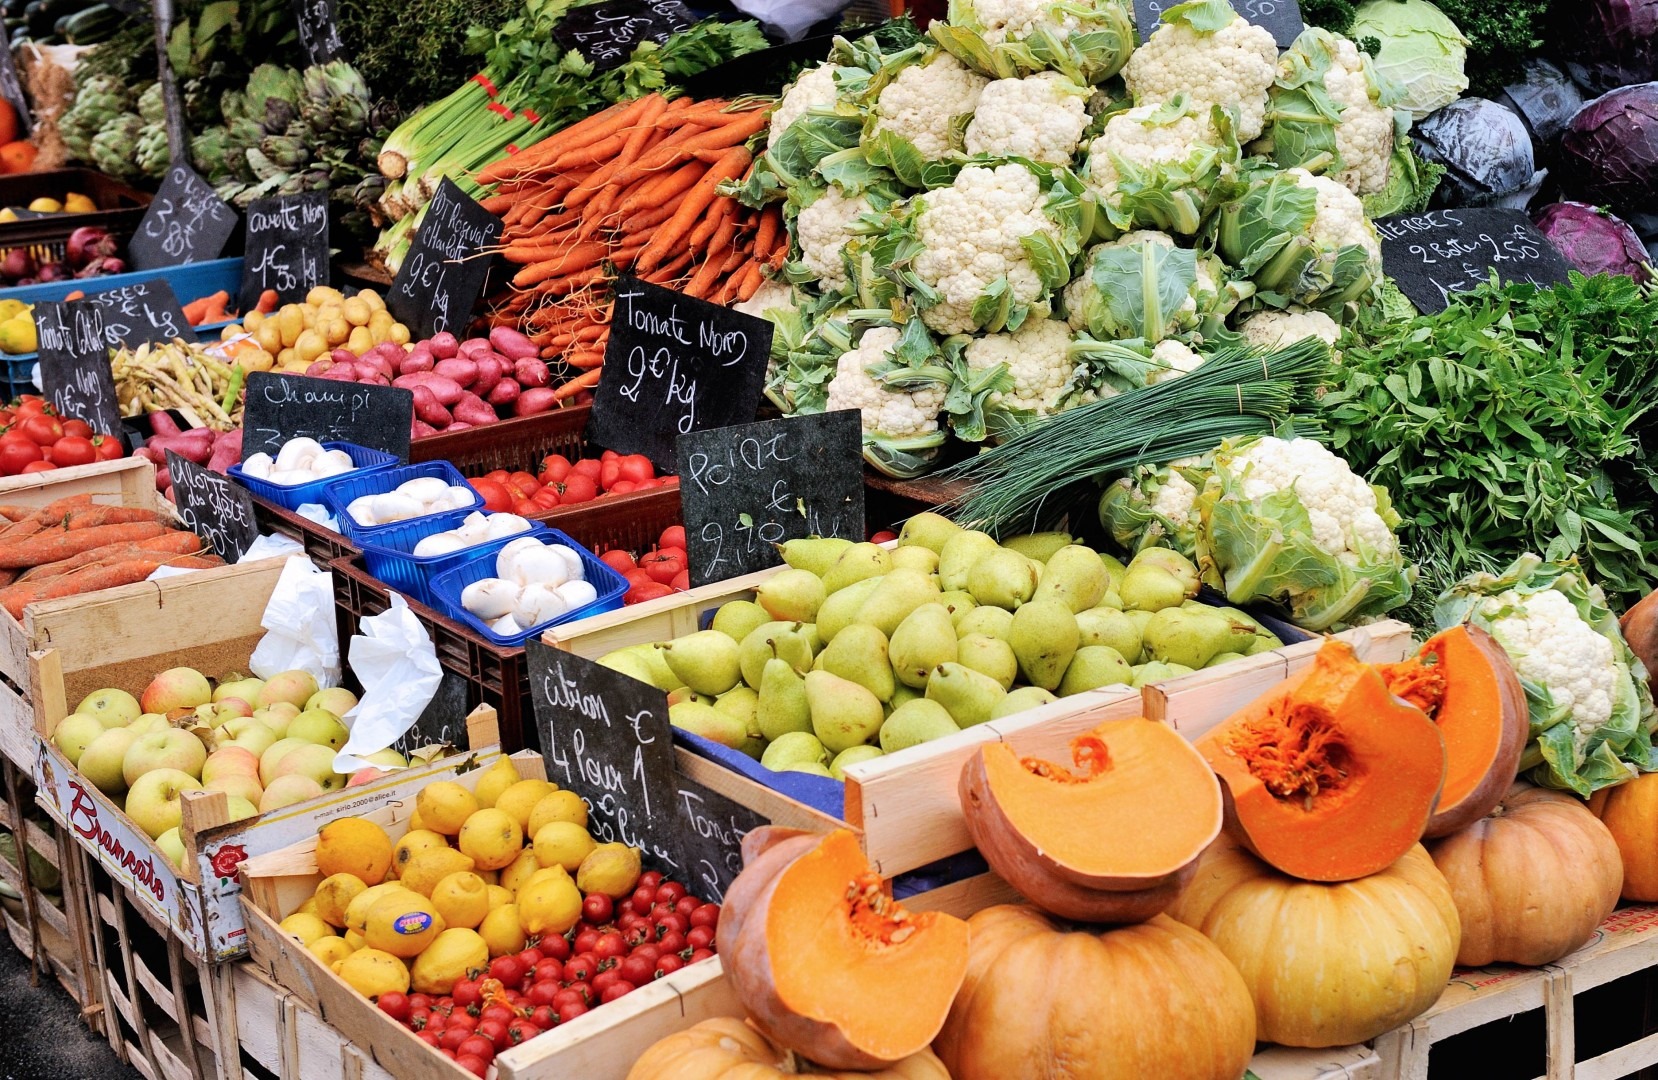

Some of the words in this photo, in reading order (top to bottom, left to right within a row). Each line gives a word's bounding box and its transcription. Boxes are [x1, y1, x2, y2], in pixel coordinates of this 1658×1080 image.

[1409, 245, 1437, 264] 2
[618, 289, 693, 345] Tomate
[67, 779, 165, 902] Brancato
